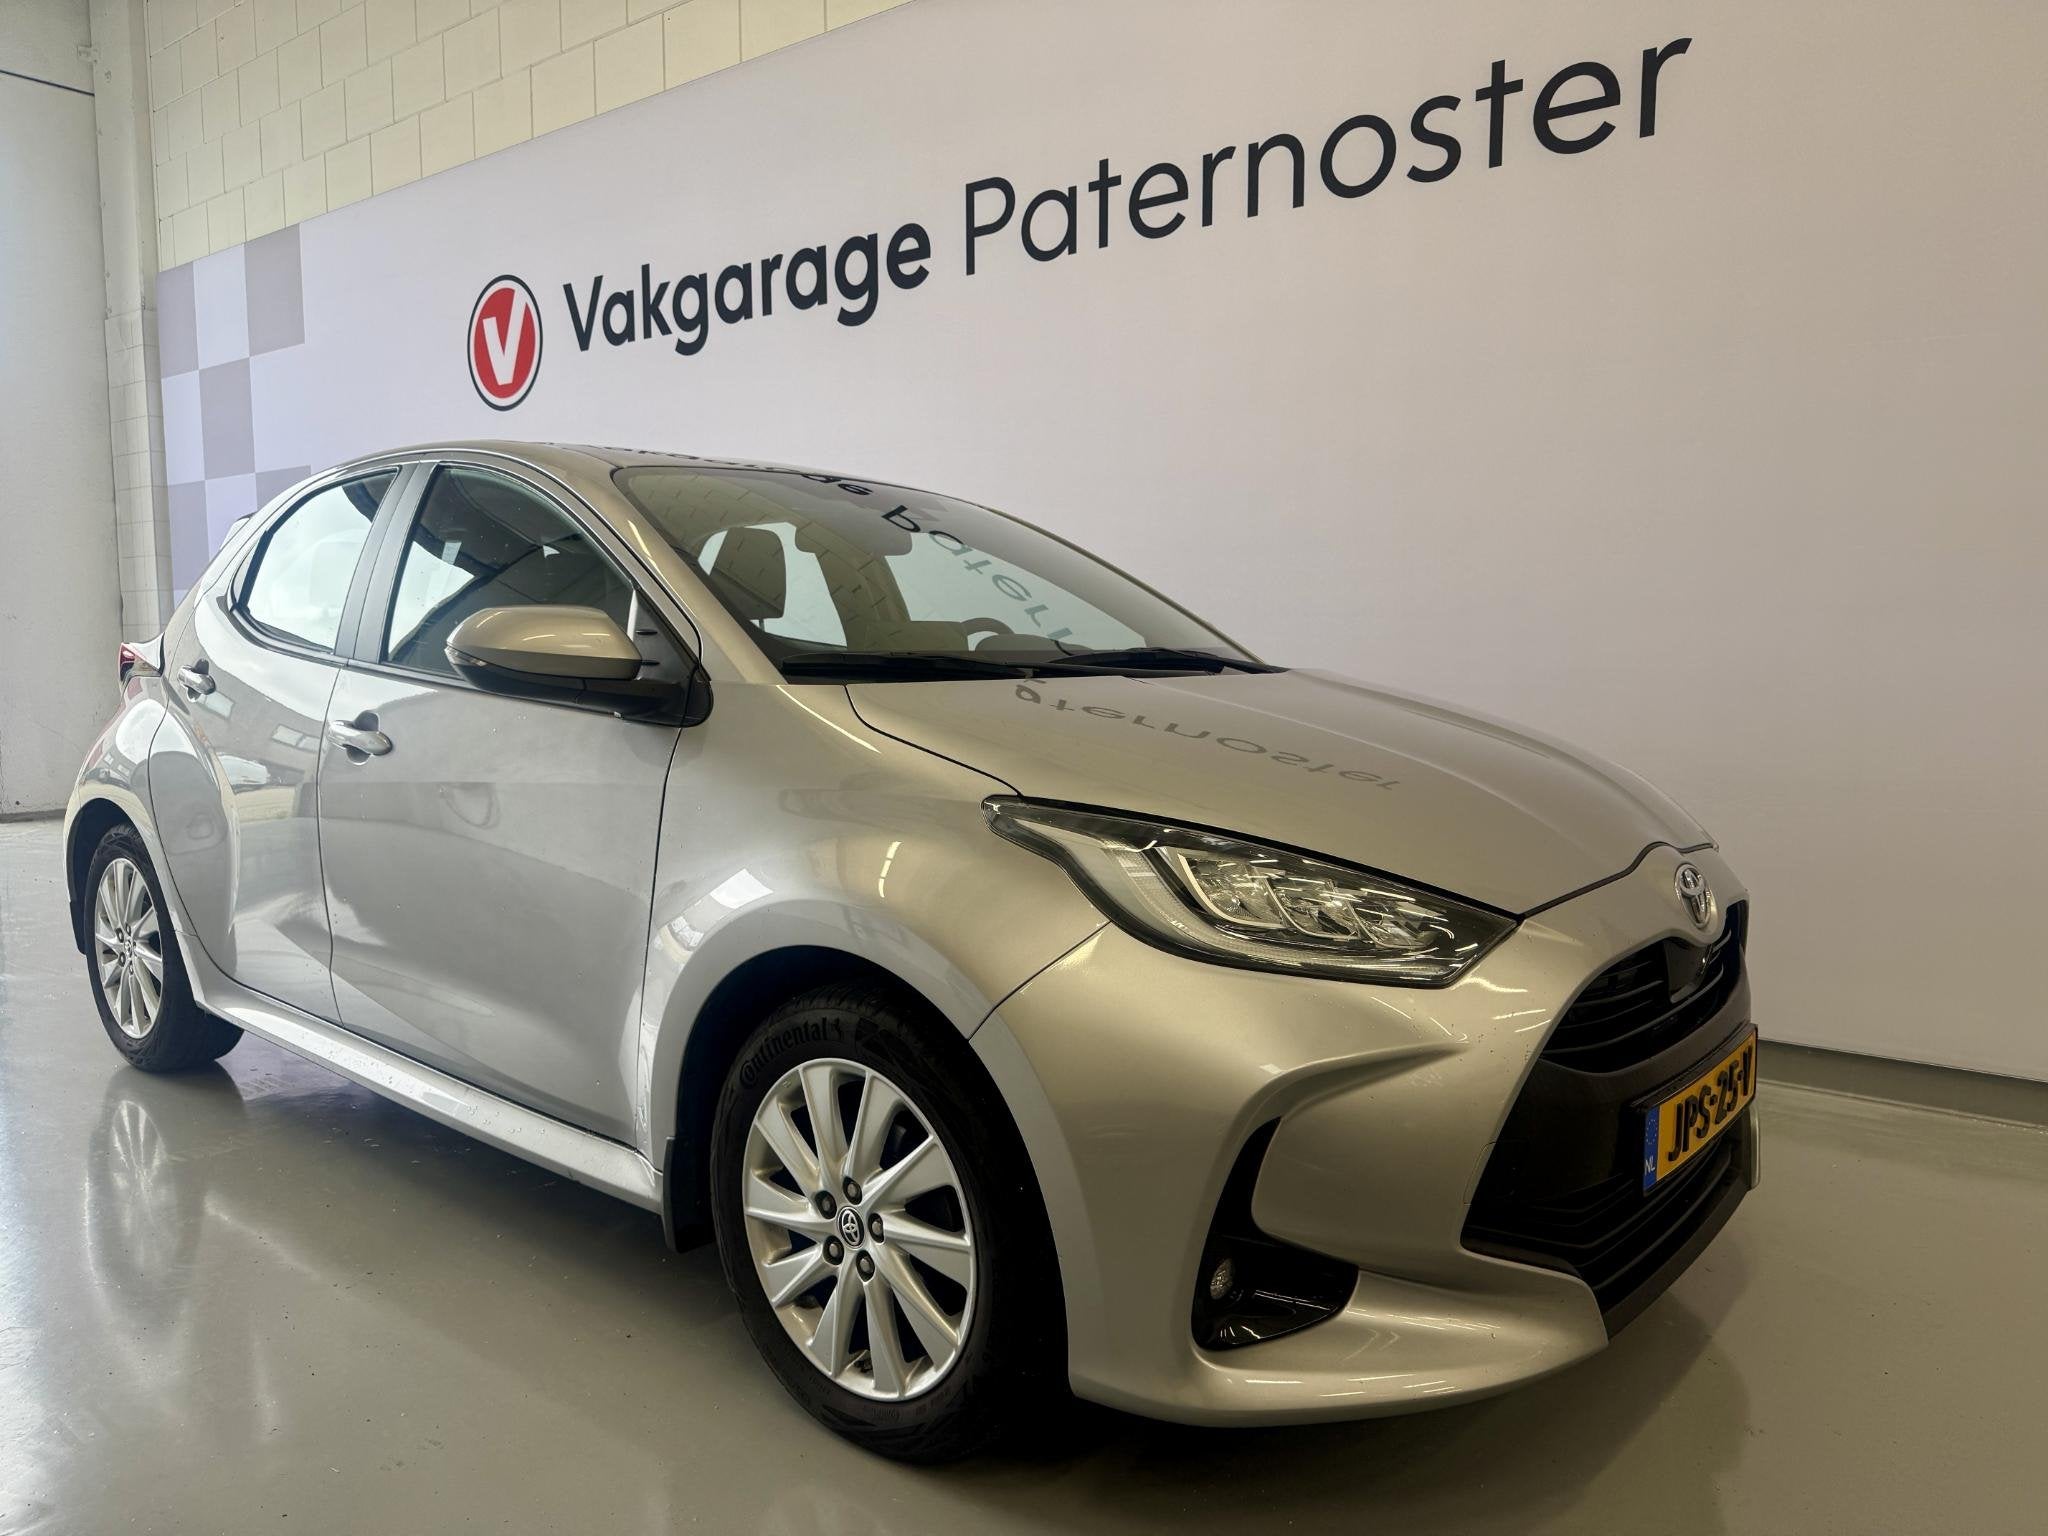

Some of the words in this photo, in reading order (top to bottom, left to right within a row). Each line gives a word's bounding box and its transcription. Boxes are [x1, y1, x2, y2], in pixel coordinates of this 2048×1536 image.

[563, 223, 931, 355] Vakgarage
[966, 38, 1693, 275] Paternoster
[740, 1016, 829, 1088] Continental
[1644, 1156, 1656, 1175] NL
